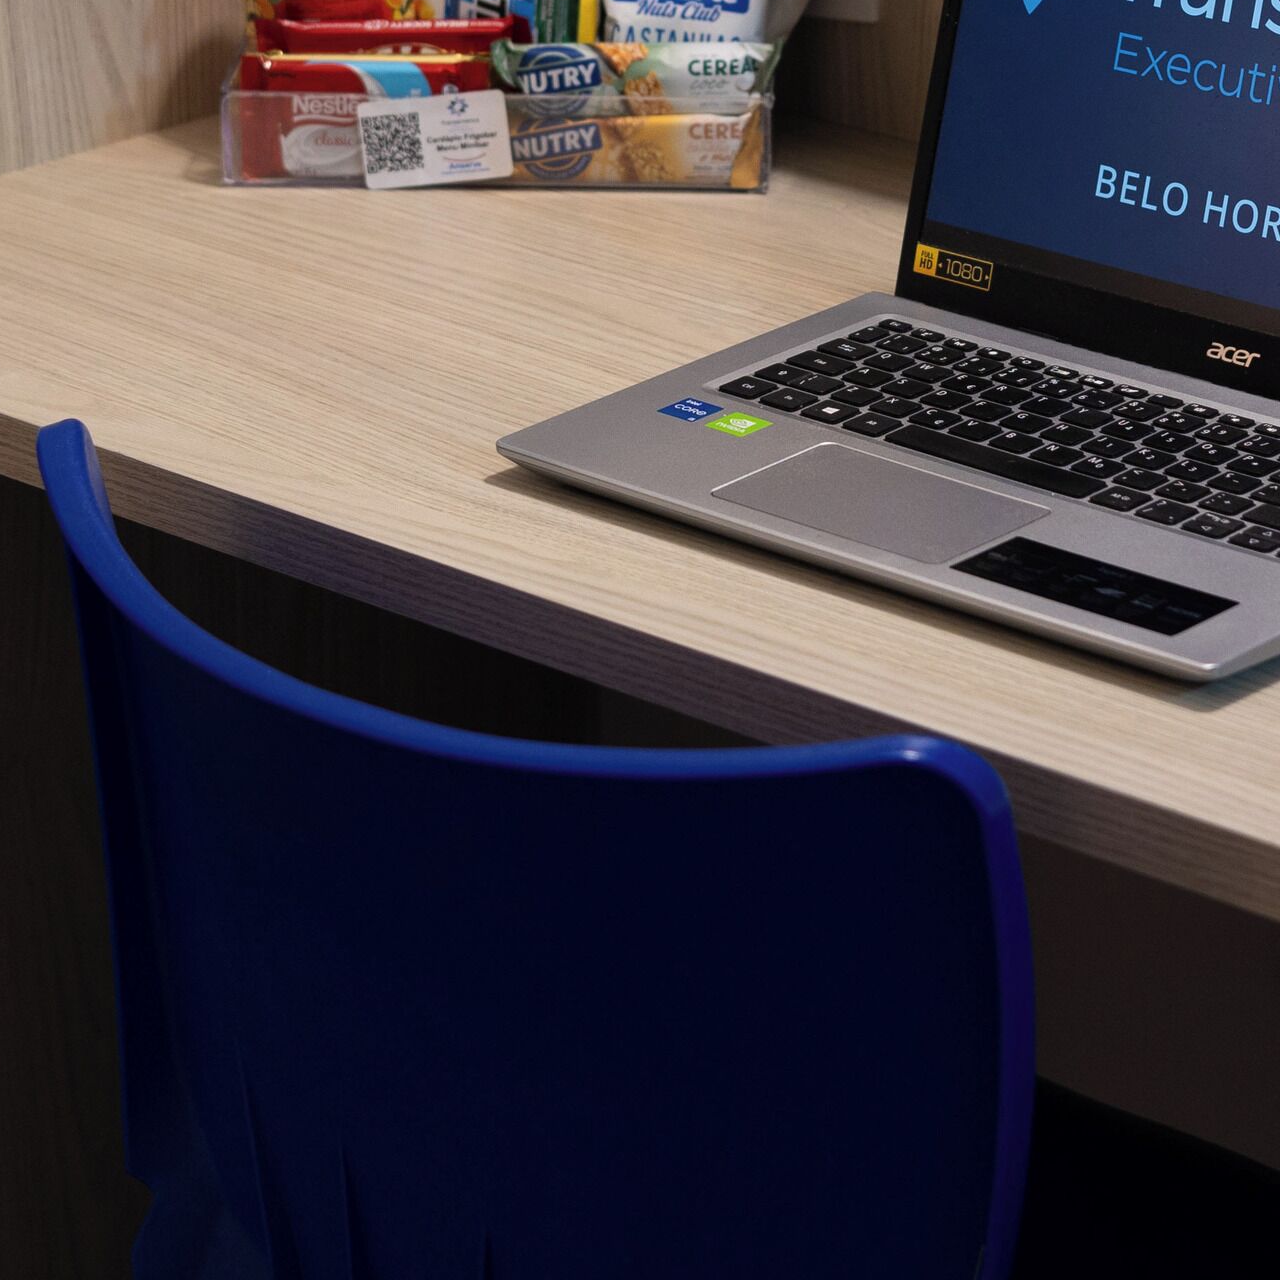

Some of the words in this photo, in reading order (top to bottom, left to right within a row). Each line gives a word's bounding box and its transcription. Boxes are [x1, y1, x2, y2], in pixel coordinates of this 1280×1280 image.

[680, 2, 721, 22] Club
[520, 62, 597, 95] NUTRY
[512, 125, 598, 158] NUTRY
[1095, 164, 1190, 218] BELO
[919, 258, 933, 270] HD
[920, 250, 933, 259] FULL
[946, 258, 983, 282] 1080
[1206, 342, 1261, 368] acer
